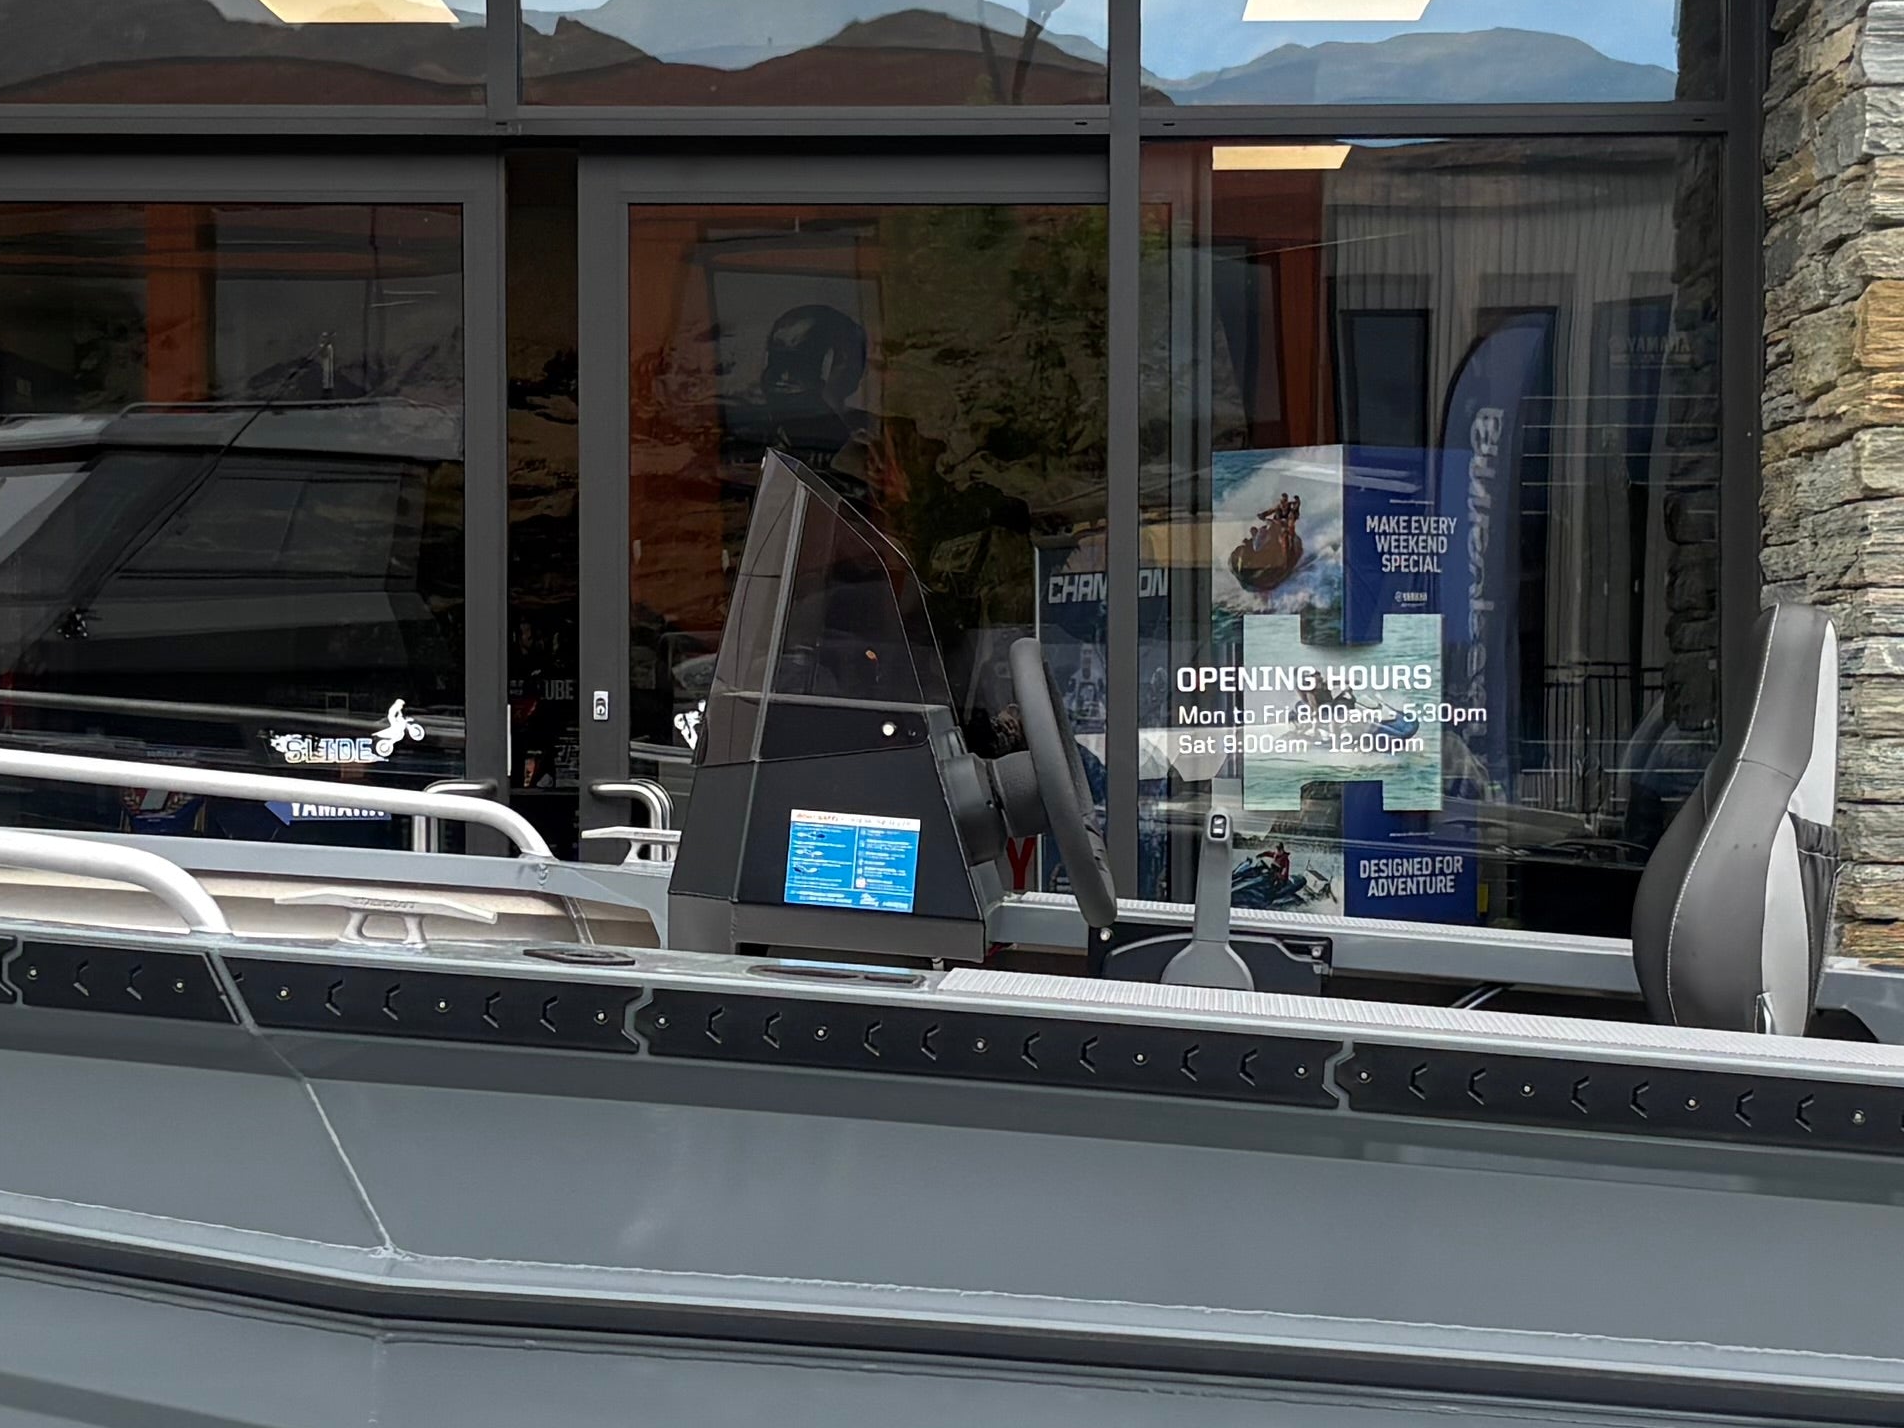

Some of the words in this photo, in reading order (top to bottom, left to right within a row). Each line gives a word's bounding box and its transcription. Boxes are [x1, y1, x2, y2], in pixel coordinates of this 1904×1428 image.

[1366, 515, 1409, 533] MAKE
[1411, 516, 1457, 535] EVERY
[1375, 535, 1448, 554] WEEKEND
[1381, 554, 1442, 573] SPECIAL
[1176, 665, 1317, 694] OPENING
[1327, 664, 1432, 691] HOURS
[1179, 705, 1225, 725] Mon
[1233, 706, 1255, 725] to
[1263, 704, 1289, 724] Fri
[1297, 704, 1383, 724] 8:00am
[1403, 703, 1488, 726] 5:30pm
[284, 737, 373, 764] SLIDE
[1178, 734, 1216, 755] Sat
[1223, 734, 1308, 755] 9:00am
[1328, 733, 1424, 756] 12:00pm
[1359, 857, 1433, 879] DESIGNED
[1435, 856, 1463, 875] FOR
[1367, 875, 1456, 898] ADVENTURE
